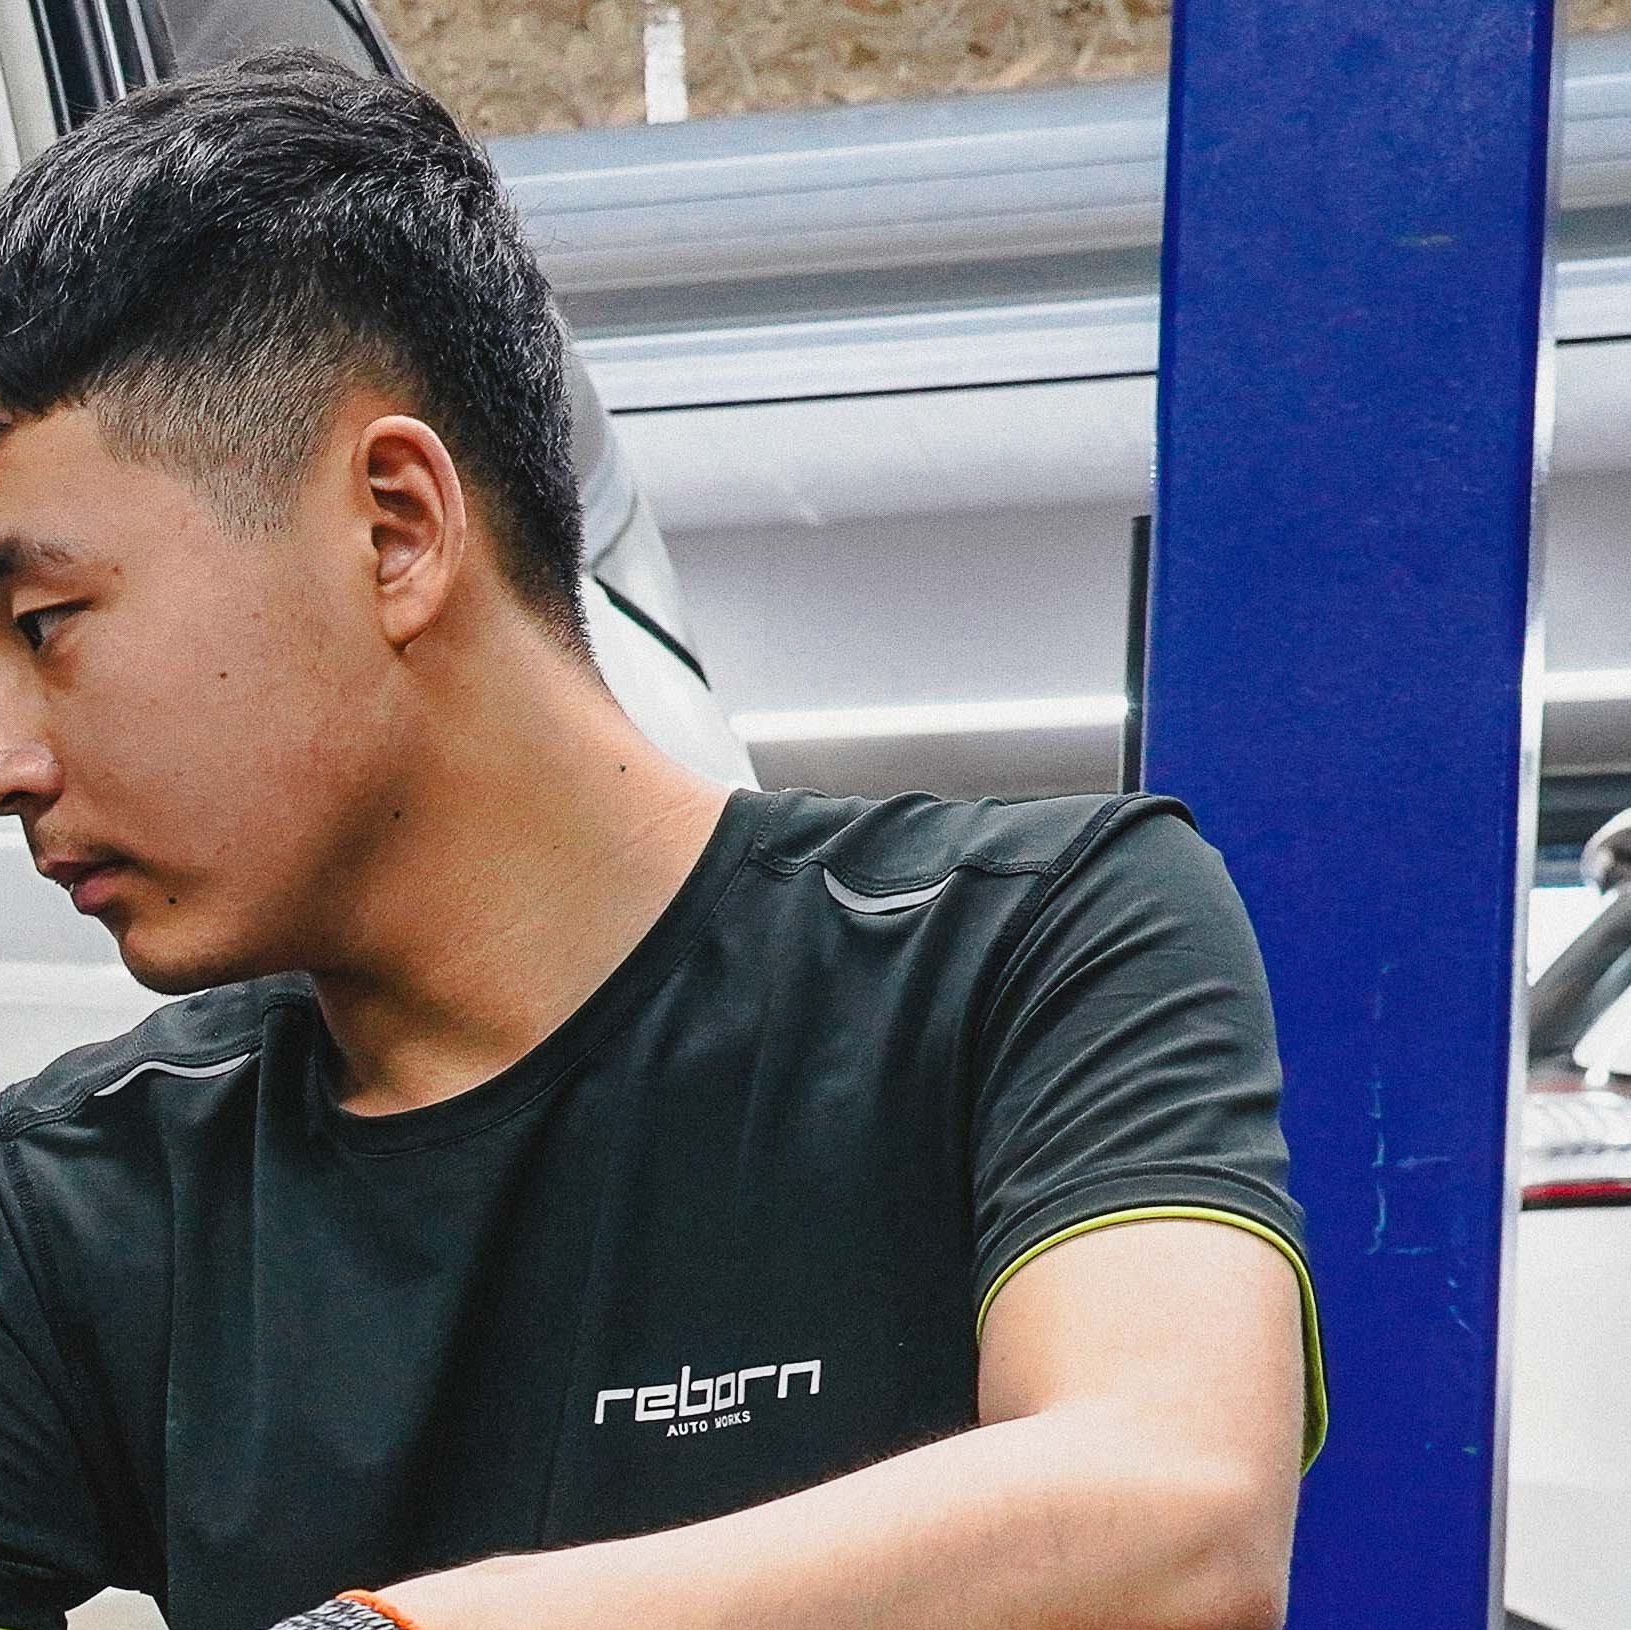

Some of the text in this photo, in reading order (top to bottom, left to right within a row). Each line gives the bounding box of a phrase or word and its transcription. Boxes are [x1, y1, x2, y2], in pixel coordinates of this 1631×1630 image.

[594, 1359, 822, 1425] reborn
[666, 1410, 752, 1438] AUTO WORKS
